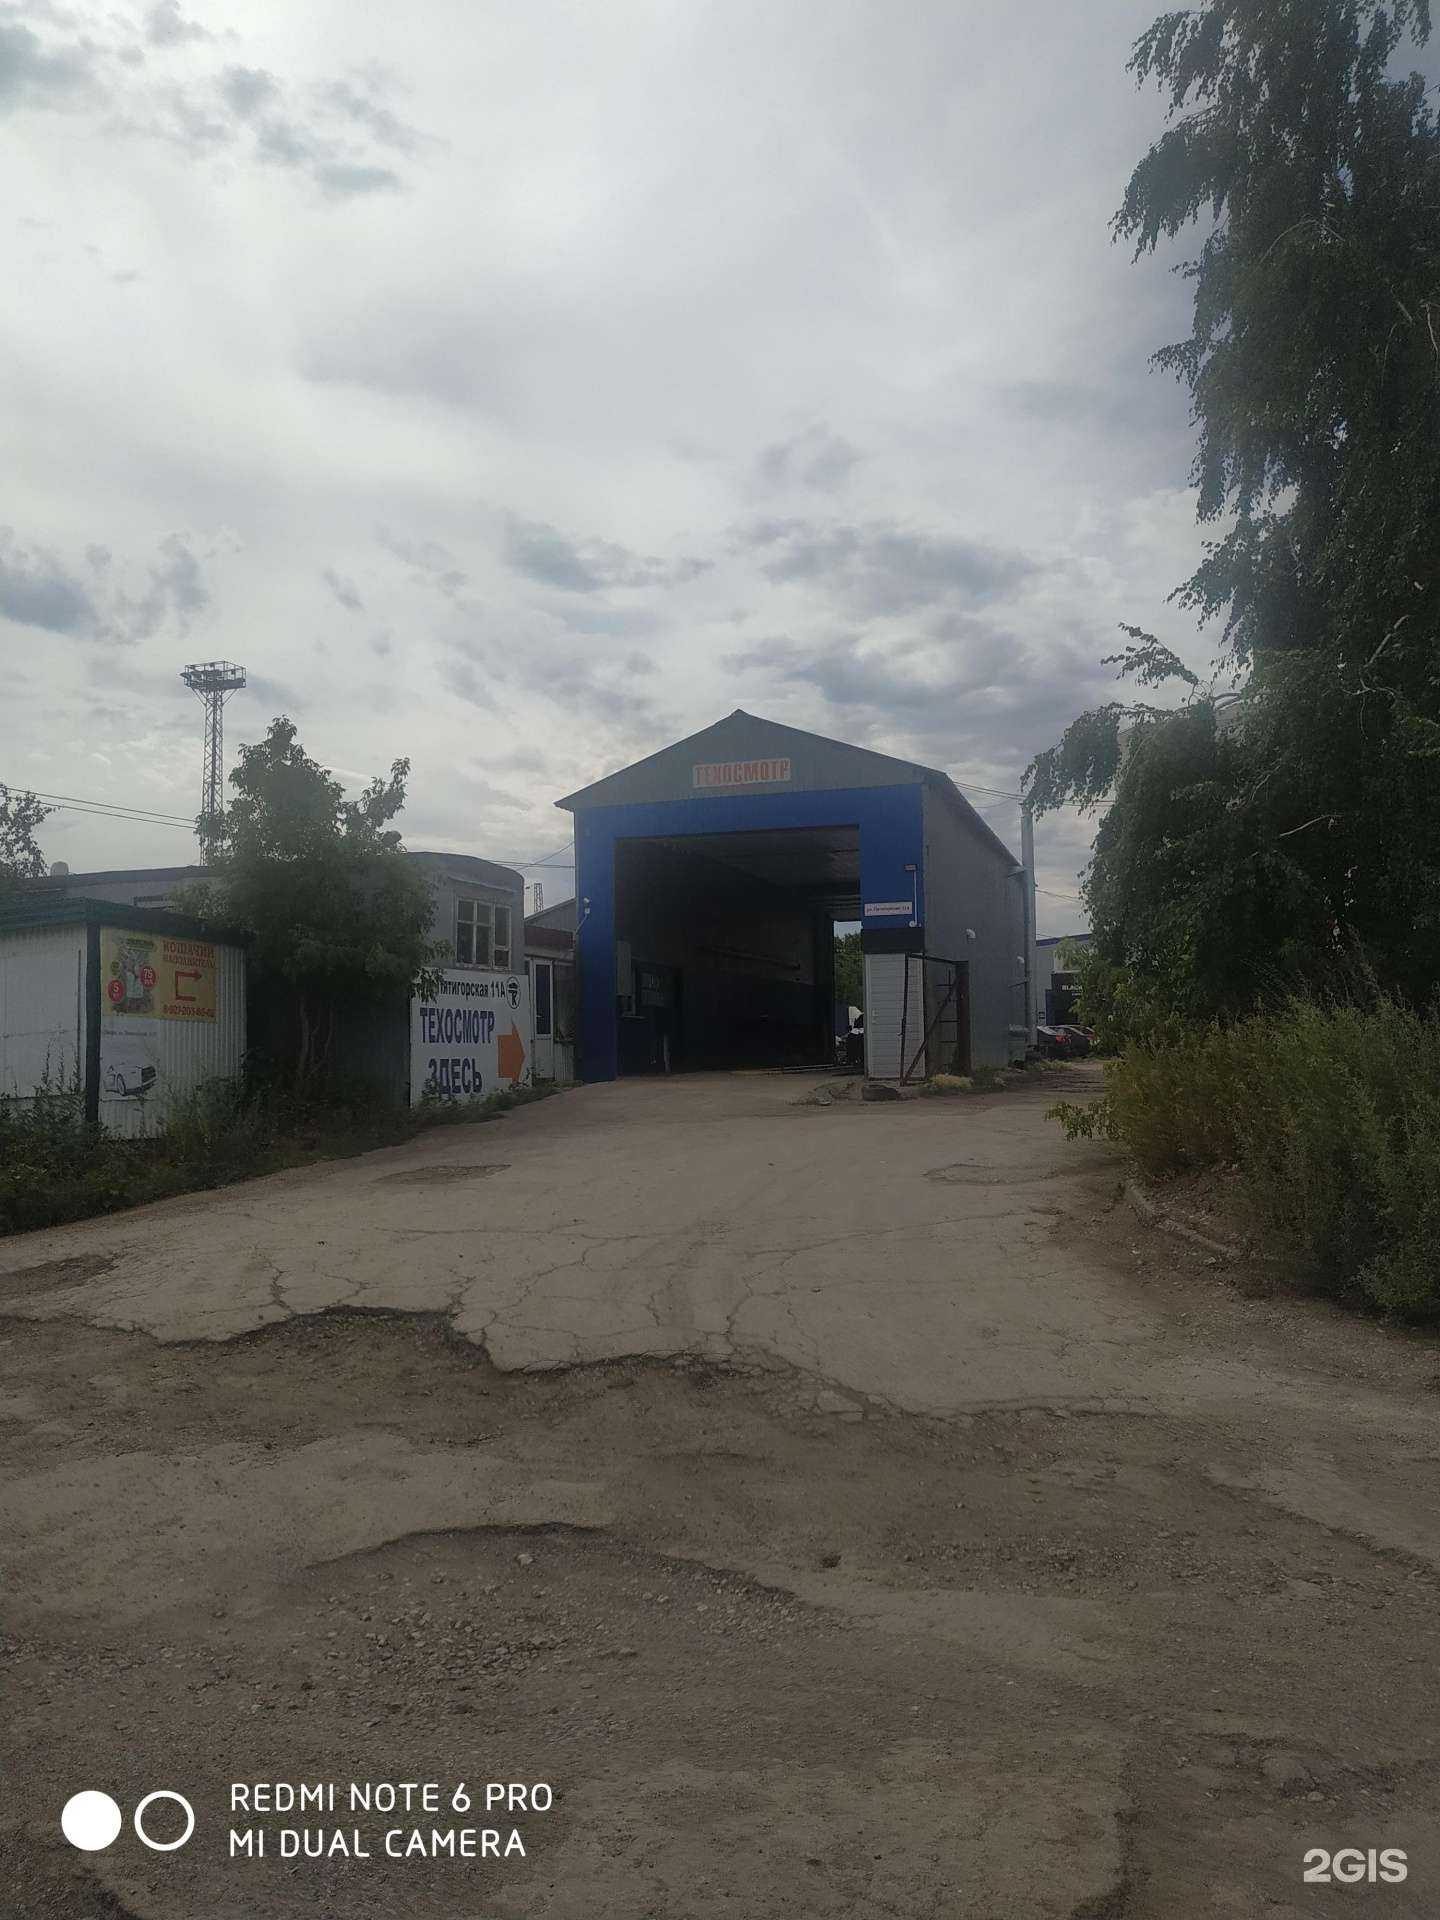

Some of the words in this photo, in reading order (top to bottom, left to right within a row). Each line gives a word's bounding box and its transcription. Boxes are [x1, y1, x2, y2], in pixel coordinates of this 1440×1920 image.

[695, 760, 789, 785] ТЕХОСМОТР
[420, 1007, 495, 1044] ТЕХОСМОТР
[427, 1058, 482, 1097] ЗДЕСЬ
